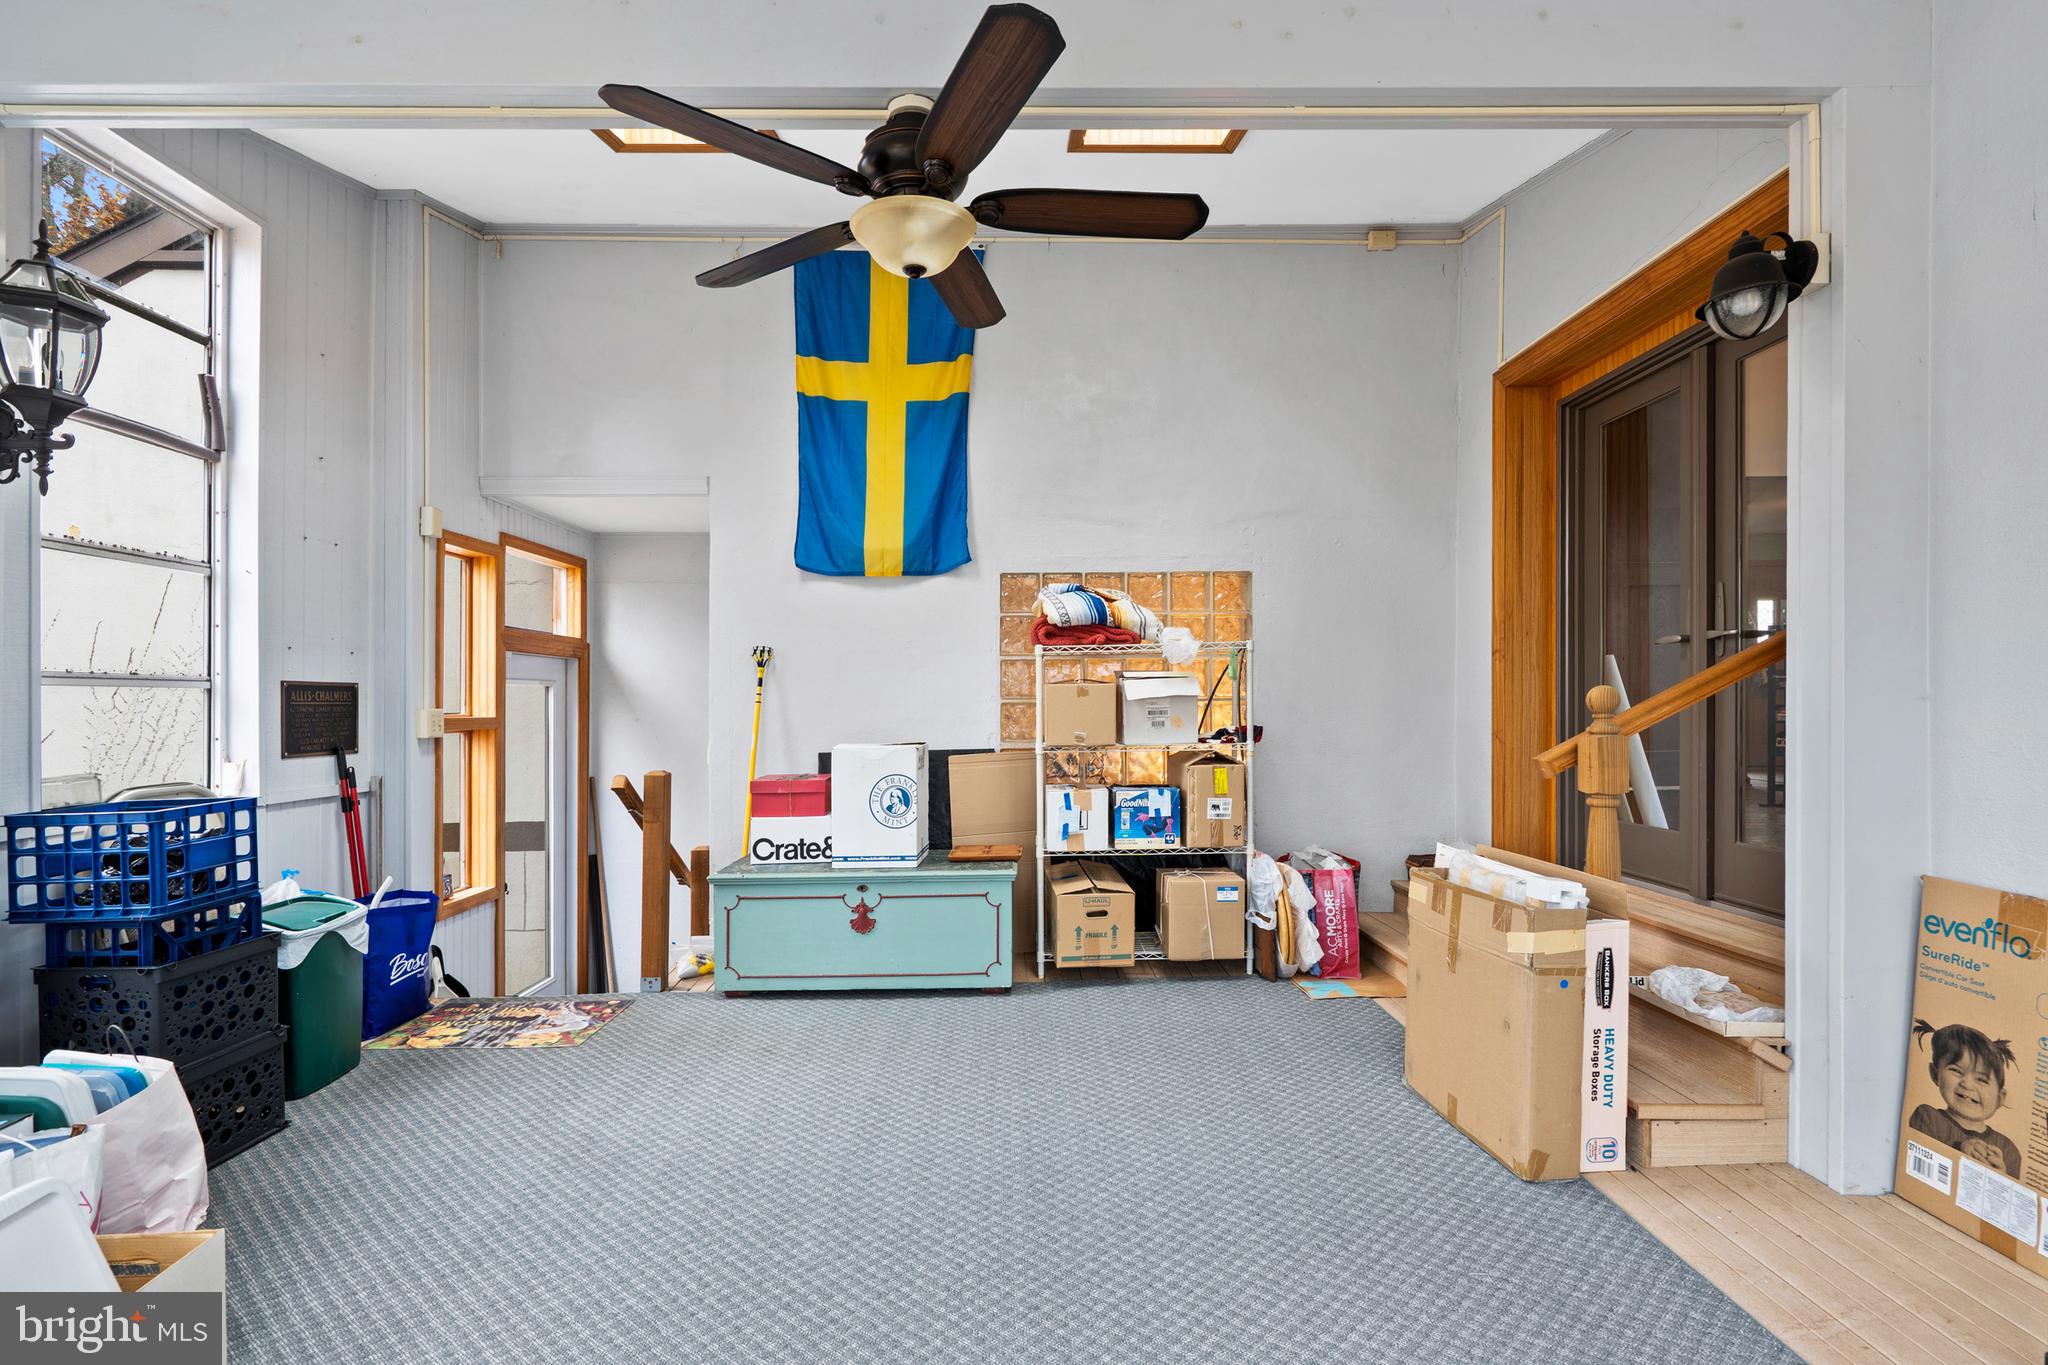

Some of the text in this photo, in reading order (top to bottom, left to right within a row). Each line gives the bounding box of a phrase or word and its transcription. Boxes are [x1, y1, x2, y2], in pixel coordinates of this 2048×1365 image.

[882, 815, 909, 826] MINT
[1923, 914, 2032, 959] evenflo
[1590, 1028, 1602, 1102] Storage Boxes
[1602, 1028, 1615, 1109] HEAVY DUTY
[1602, 1141, 1616, 1159] 10
